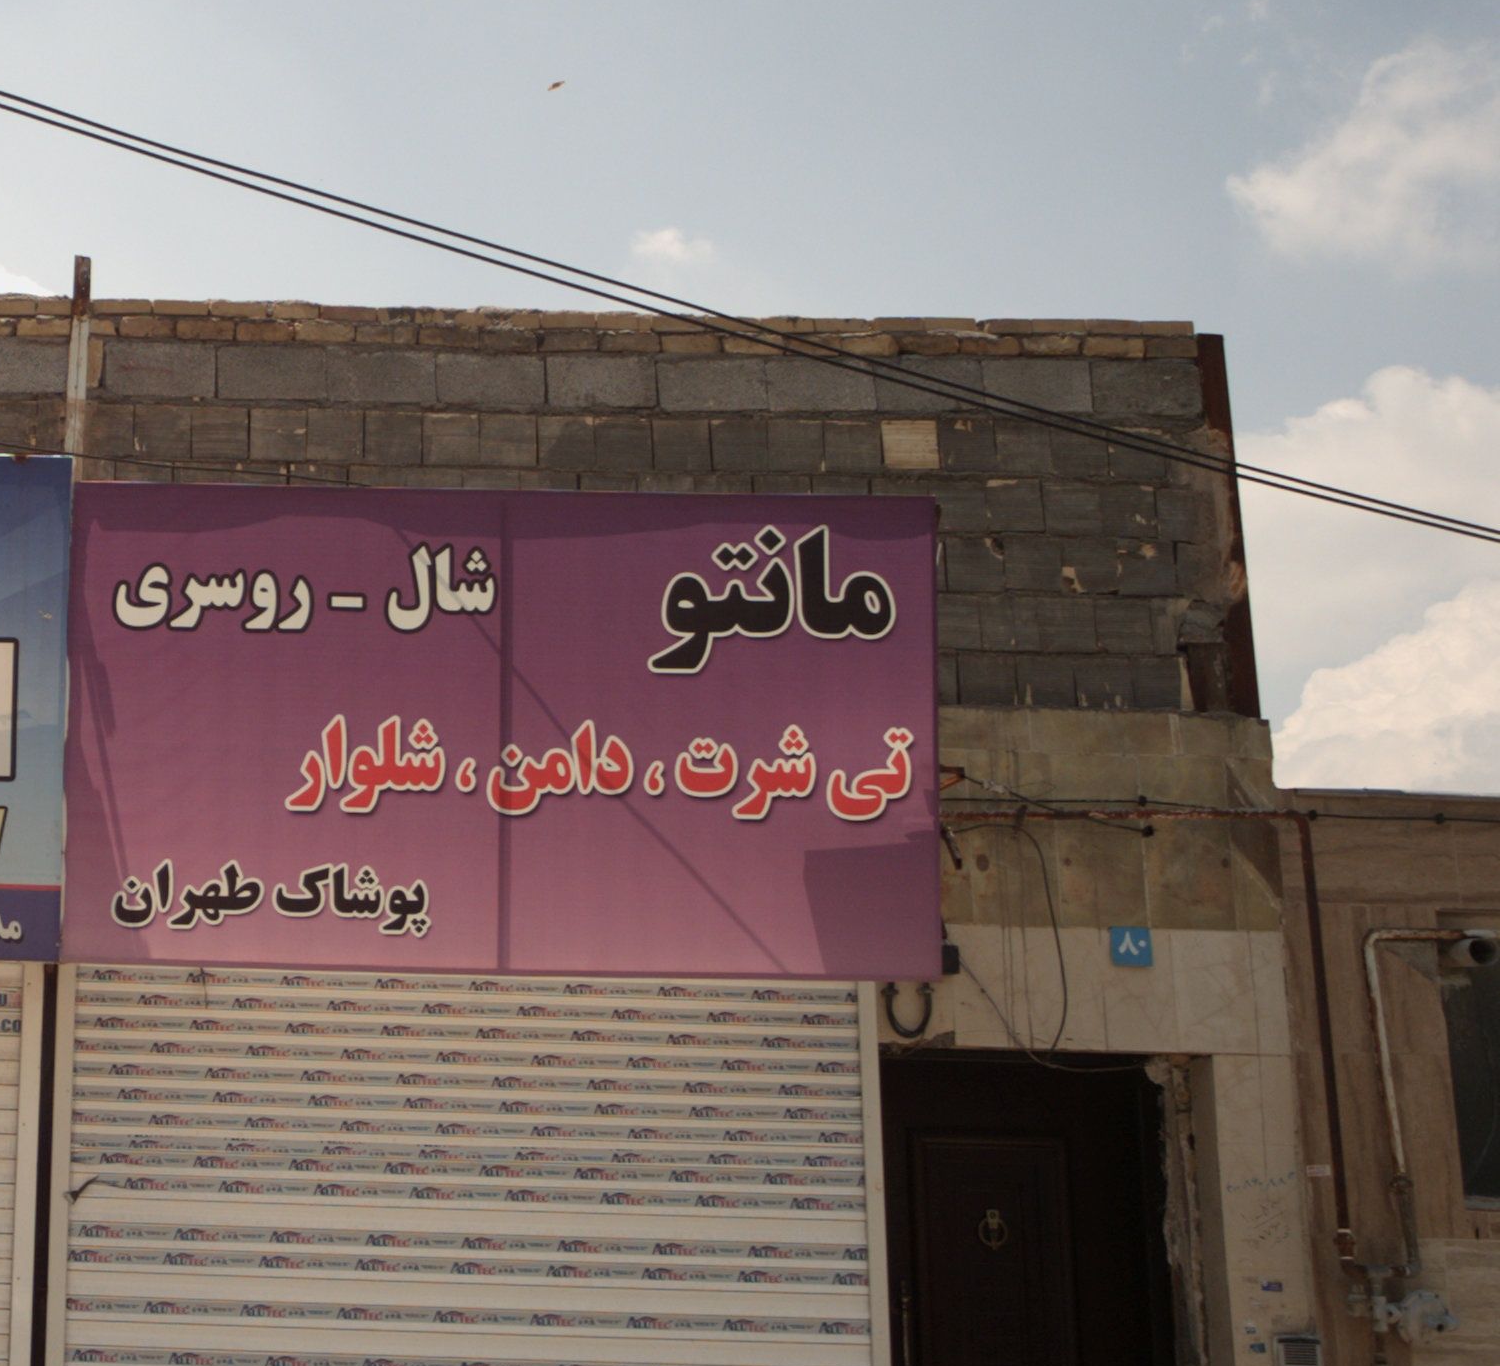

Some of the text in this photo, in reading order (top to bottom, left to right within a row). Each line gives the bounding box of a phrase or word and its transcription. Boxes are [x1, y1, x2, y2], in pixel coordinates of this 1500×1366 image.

[112, 562, 313, 632] روسری
[386, 542, 497, 632] شال
[647, 524, 896, 673] مانتو
[284, 714, 446, 812] شلوار
[827, 727, 914, 822] تی
[111, 858, 431, 937] پوشاک طهران
